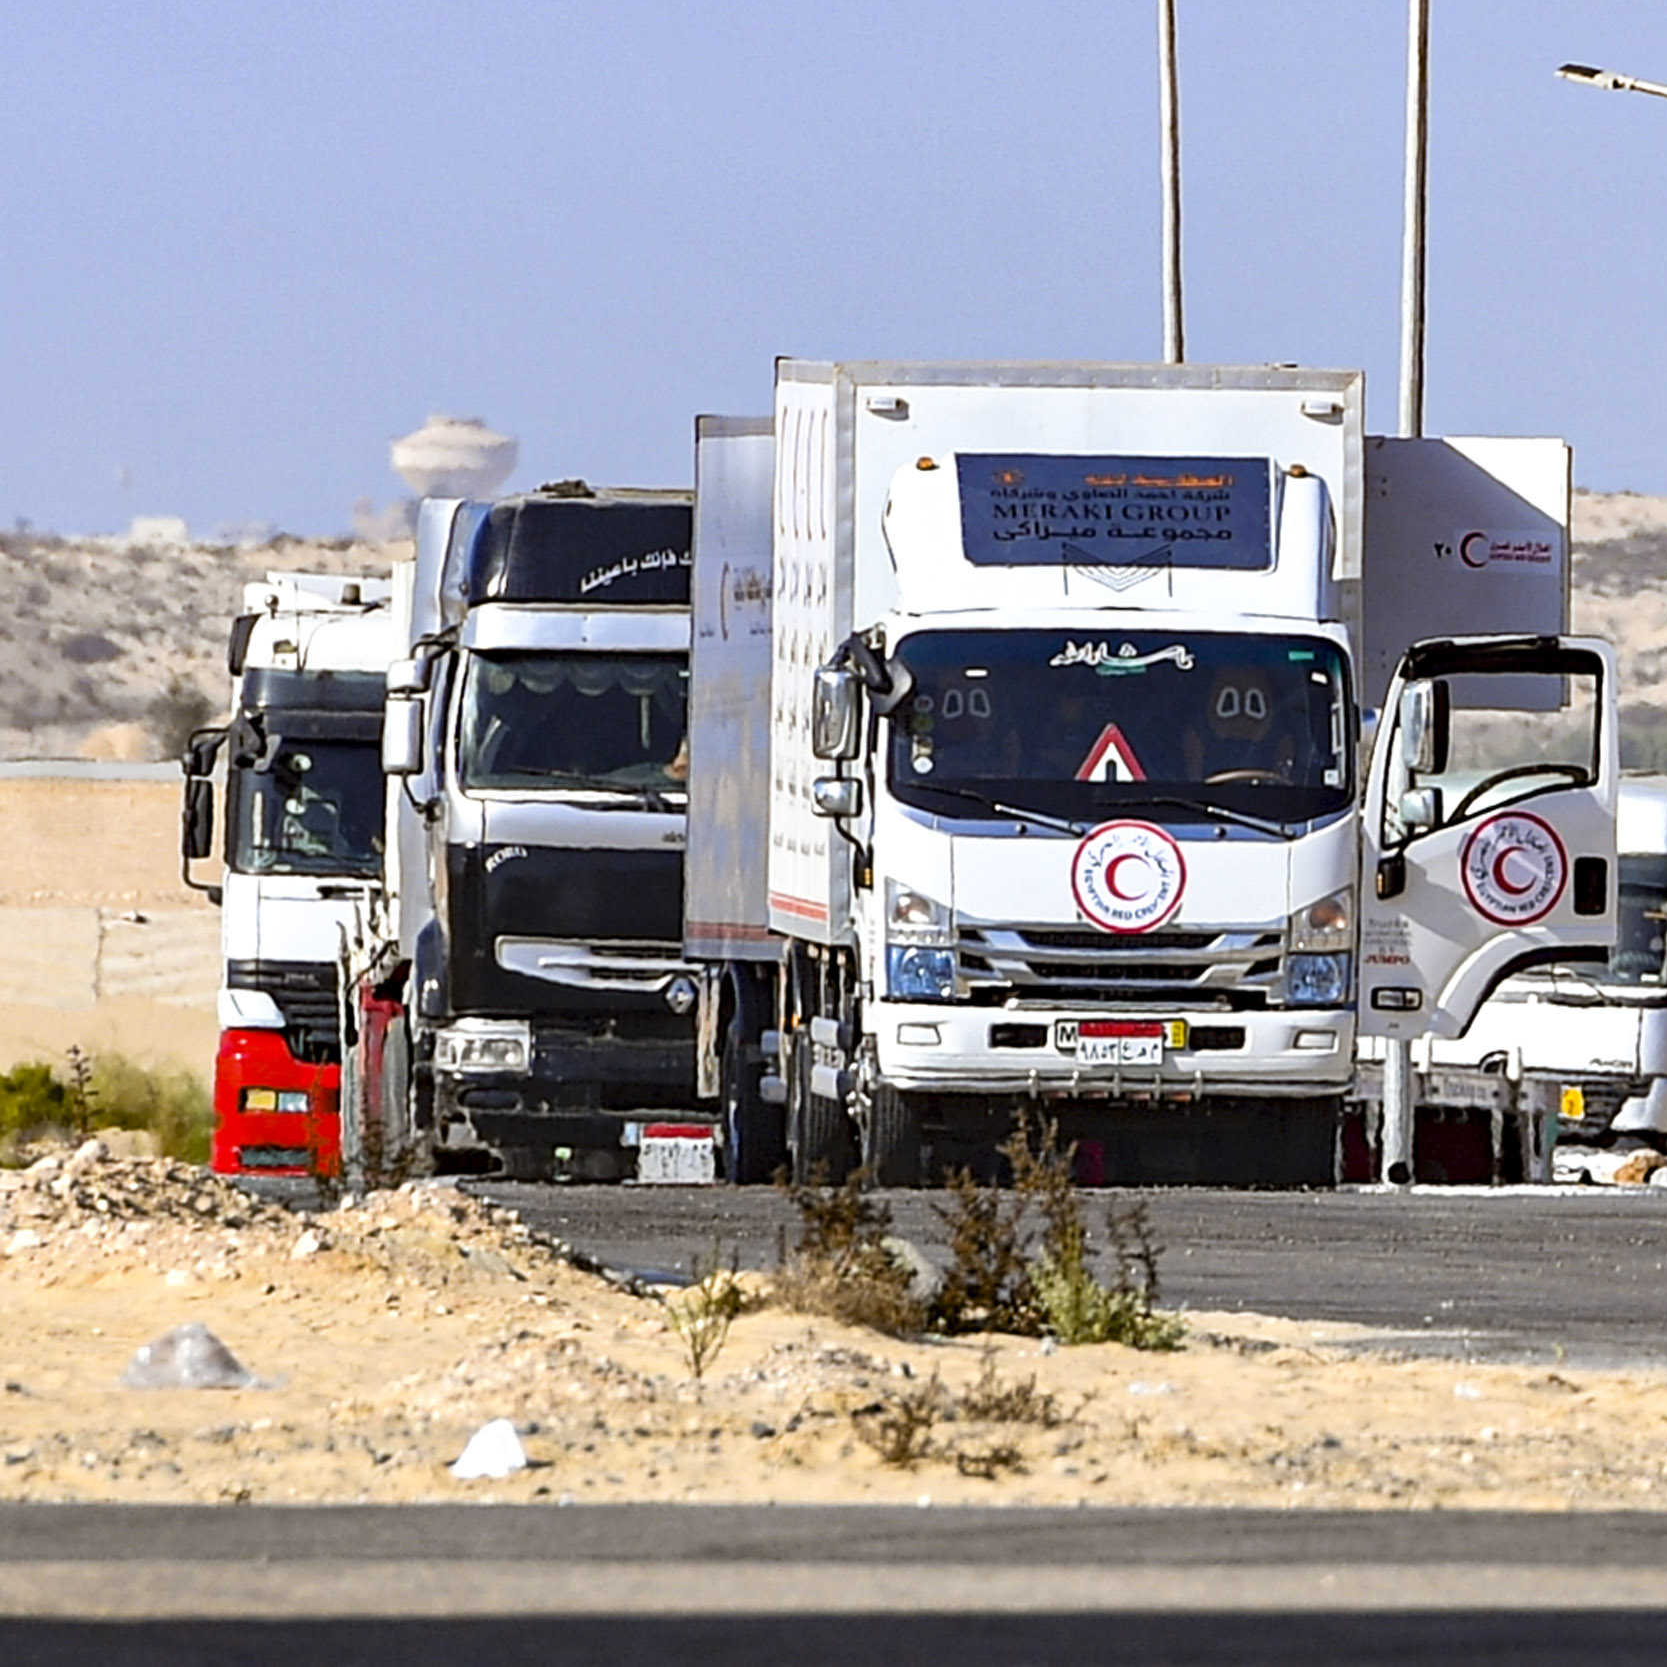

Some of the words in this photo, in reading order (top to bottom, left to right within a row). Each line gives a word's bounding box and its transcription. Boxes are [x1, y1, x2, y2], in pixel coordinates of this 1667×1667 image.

[992, 503, 1112, 520] MERAKI
[1121, 503, 1231, 521] GROUP
[1106, 522, 1233, 541] مجموعة
